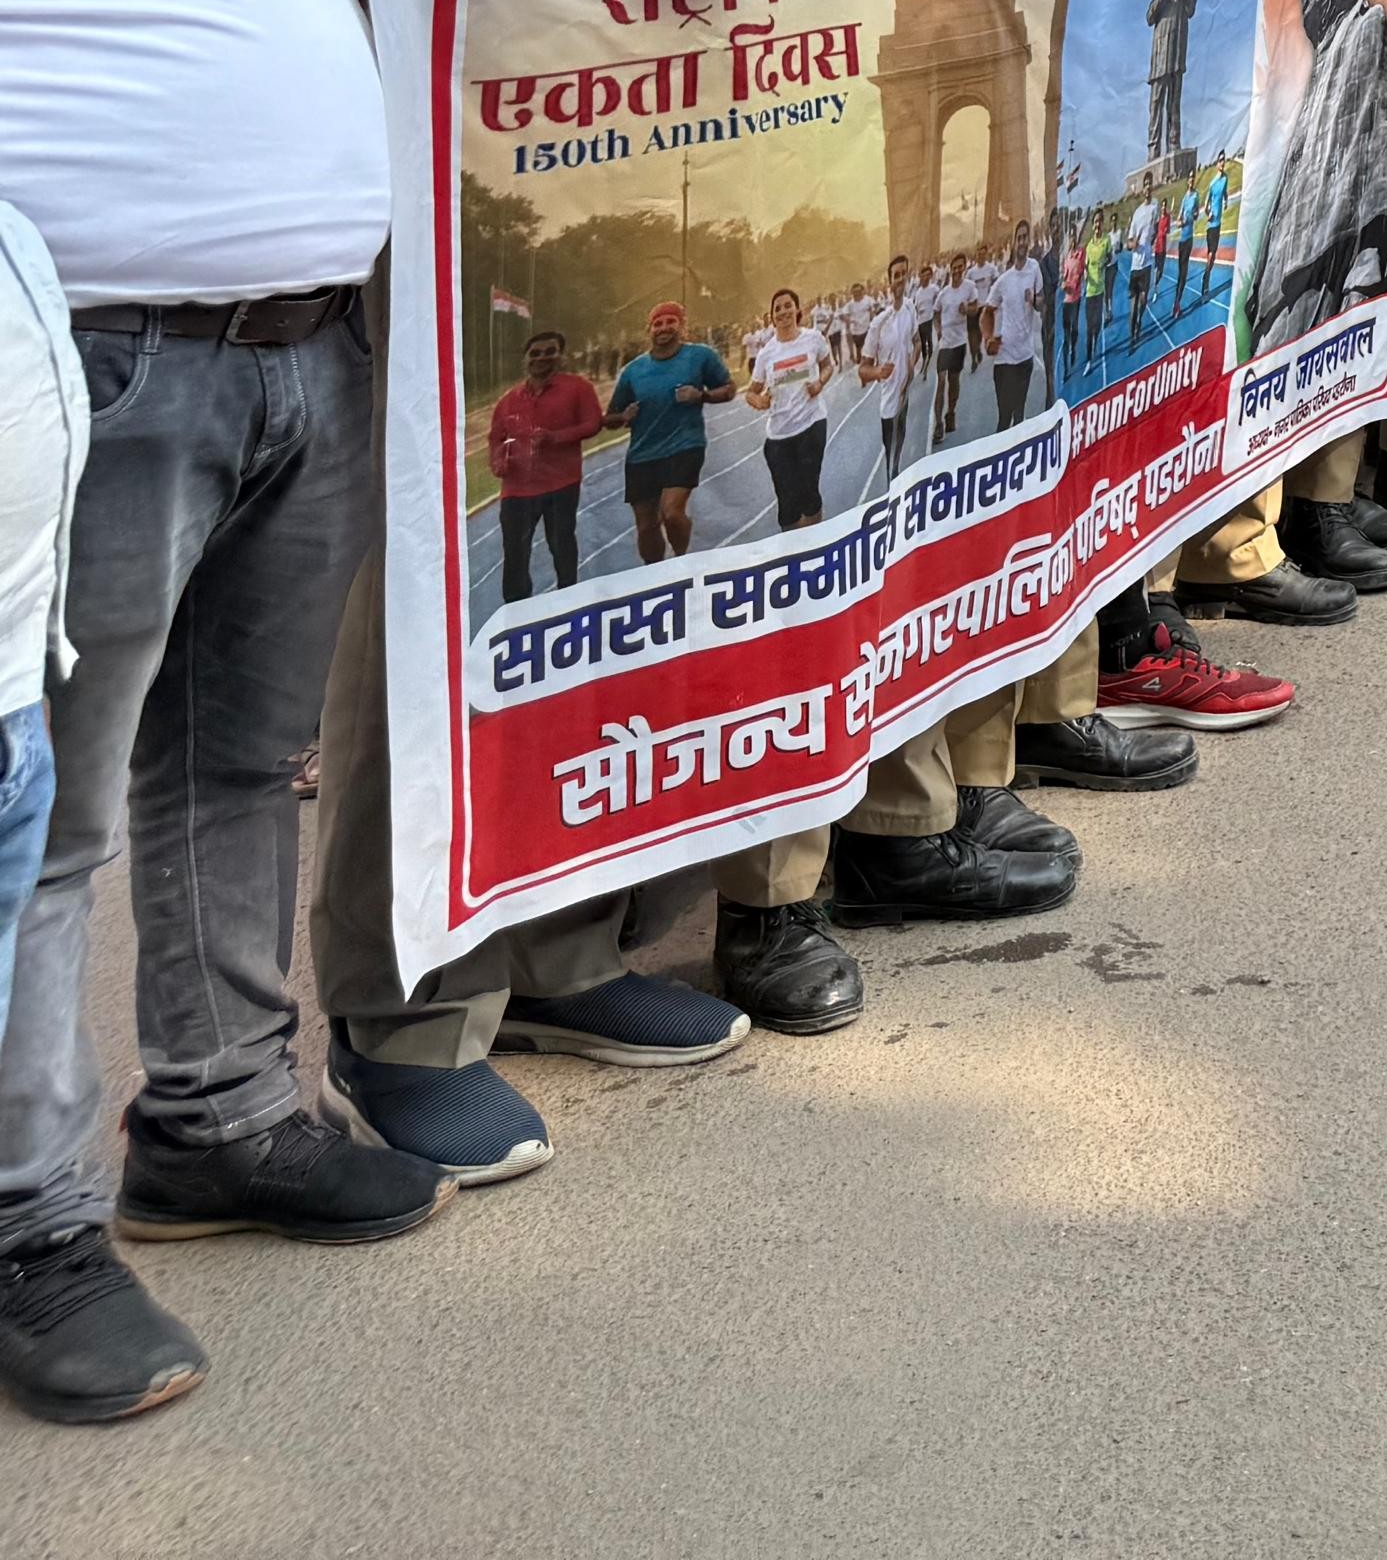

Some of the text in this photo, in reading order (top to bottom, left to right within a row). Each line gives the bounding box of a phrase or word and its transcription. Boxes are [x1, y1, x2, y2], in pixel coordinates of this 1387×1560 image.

[469, 13, 863, 133] एकता दिवस
[511, 90, 851, 176] 150th Anniversary
[1070, 342, 1204, 462] #RunForUnity
[1238, 315, 1379, 428] विनय जायसवाल
[488, 414, 1065, 694] समस्त सभासदगण
[551, 683, 834, 829] सौजन्य
[1074, 467, 1143, 567] परिषद्
[1144, 416, 1227, 513] पडरौना
